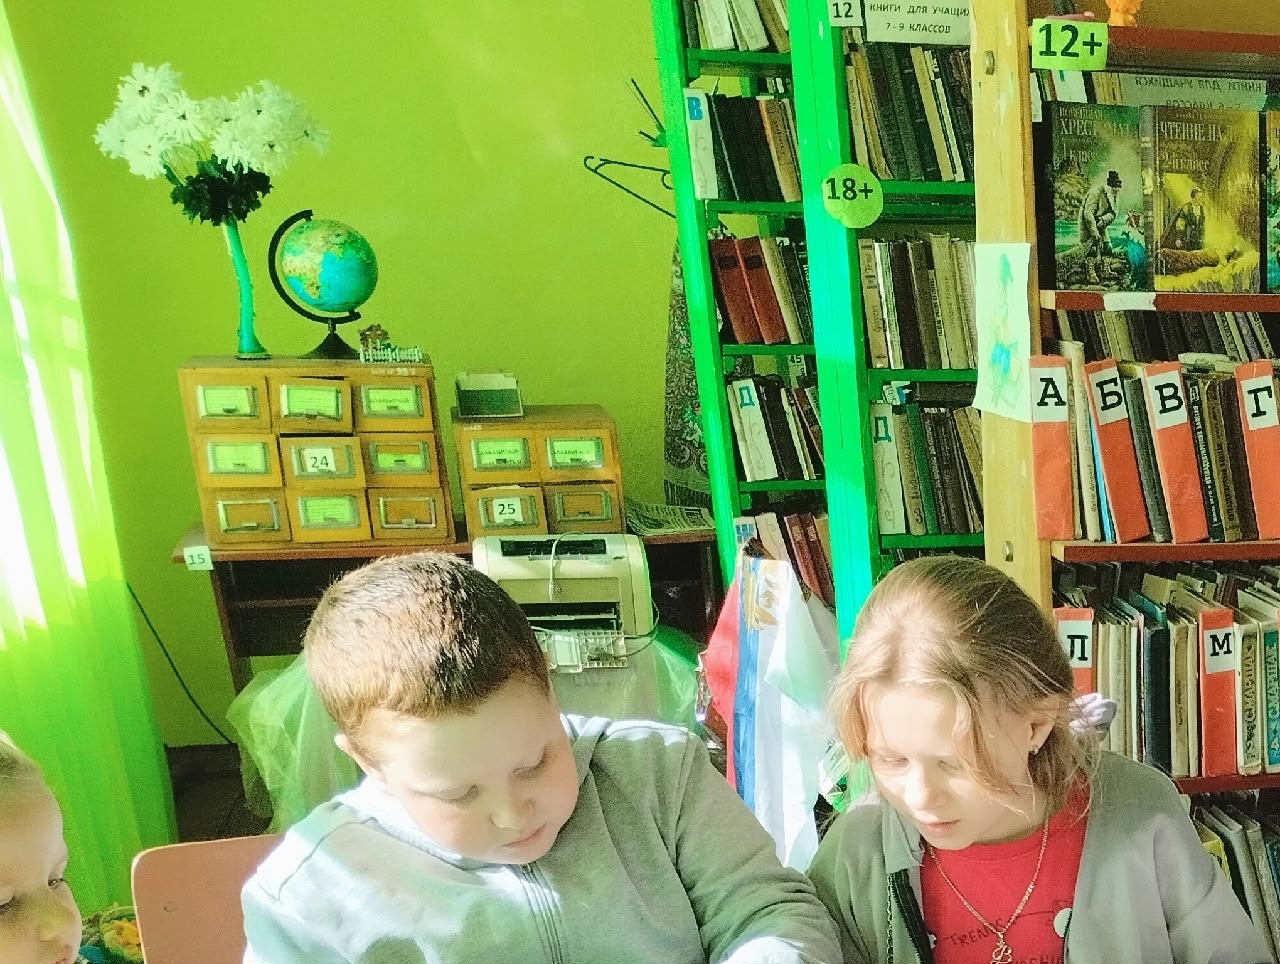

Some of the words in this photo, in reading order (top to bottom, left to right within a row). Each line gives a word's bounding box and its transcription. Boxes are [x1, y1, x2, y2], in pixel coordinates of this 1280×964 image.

[832, 2, 854, 18] 12
[870, 3, 901, 13] КНИГИ
[907, 5, 928, 15] ДЛЯ
[909, 23, 951, 34] КЛАССОВ
[1038, 22, 1103, 58] 12+
[825, 176, 874, 202] 18+
[1036, 377, 1067, 407] А
[1095, 377, 1124, 412] Б
[1153, 382, 1184, 414] В
[1247, 385, 1273, 418] Г
[309, 455, 330, 469] 24
[497, 503, 516, 515] 25
[187, 552, 207, 566] 15
[1208, 631, 1234, 658] М
